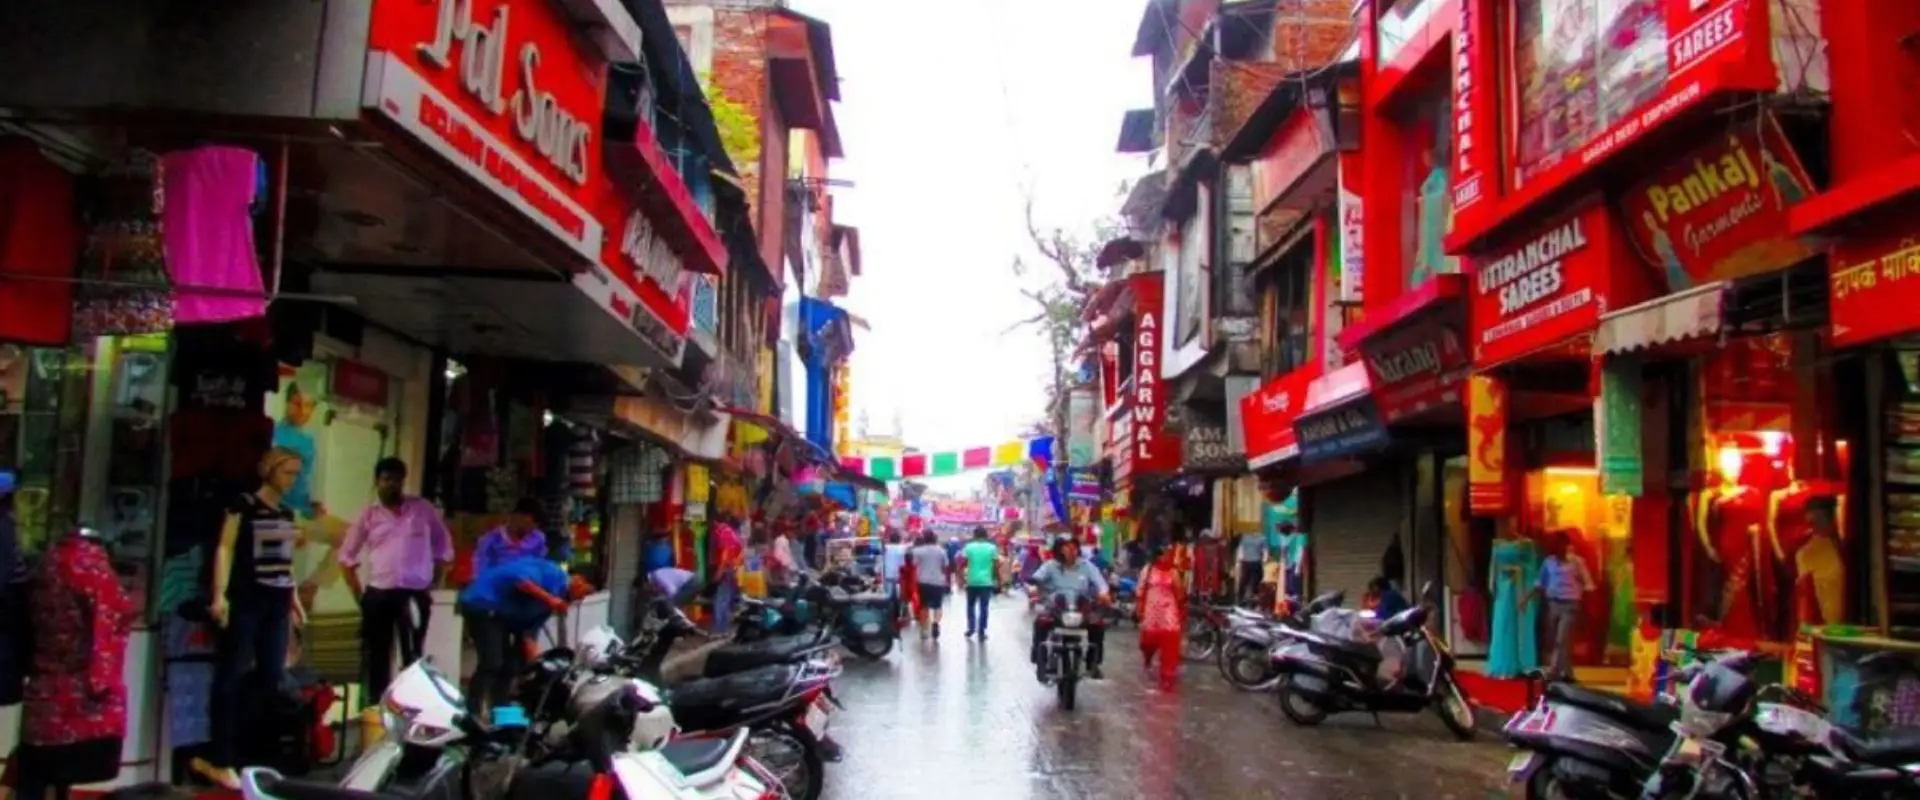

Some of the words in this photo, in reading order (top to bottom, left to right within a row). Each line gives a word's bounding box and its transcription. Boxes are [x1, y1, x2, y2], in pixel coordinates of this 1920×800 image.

[1673, 8, 1735, 68] SAREES
[511, 42, 592, 186] Sons
[1646, 134, 1760, 224] Pankaj
[1478, 217, 1588, 295] UTTRANCHAL
[1683, 192, 1764, 257] Garments
[1499, 259, 1562, 316] SAREES
[1134, 311, 1156, 459] AGGARWAL
[1369, 342, 1442, 383] Narang
